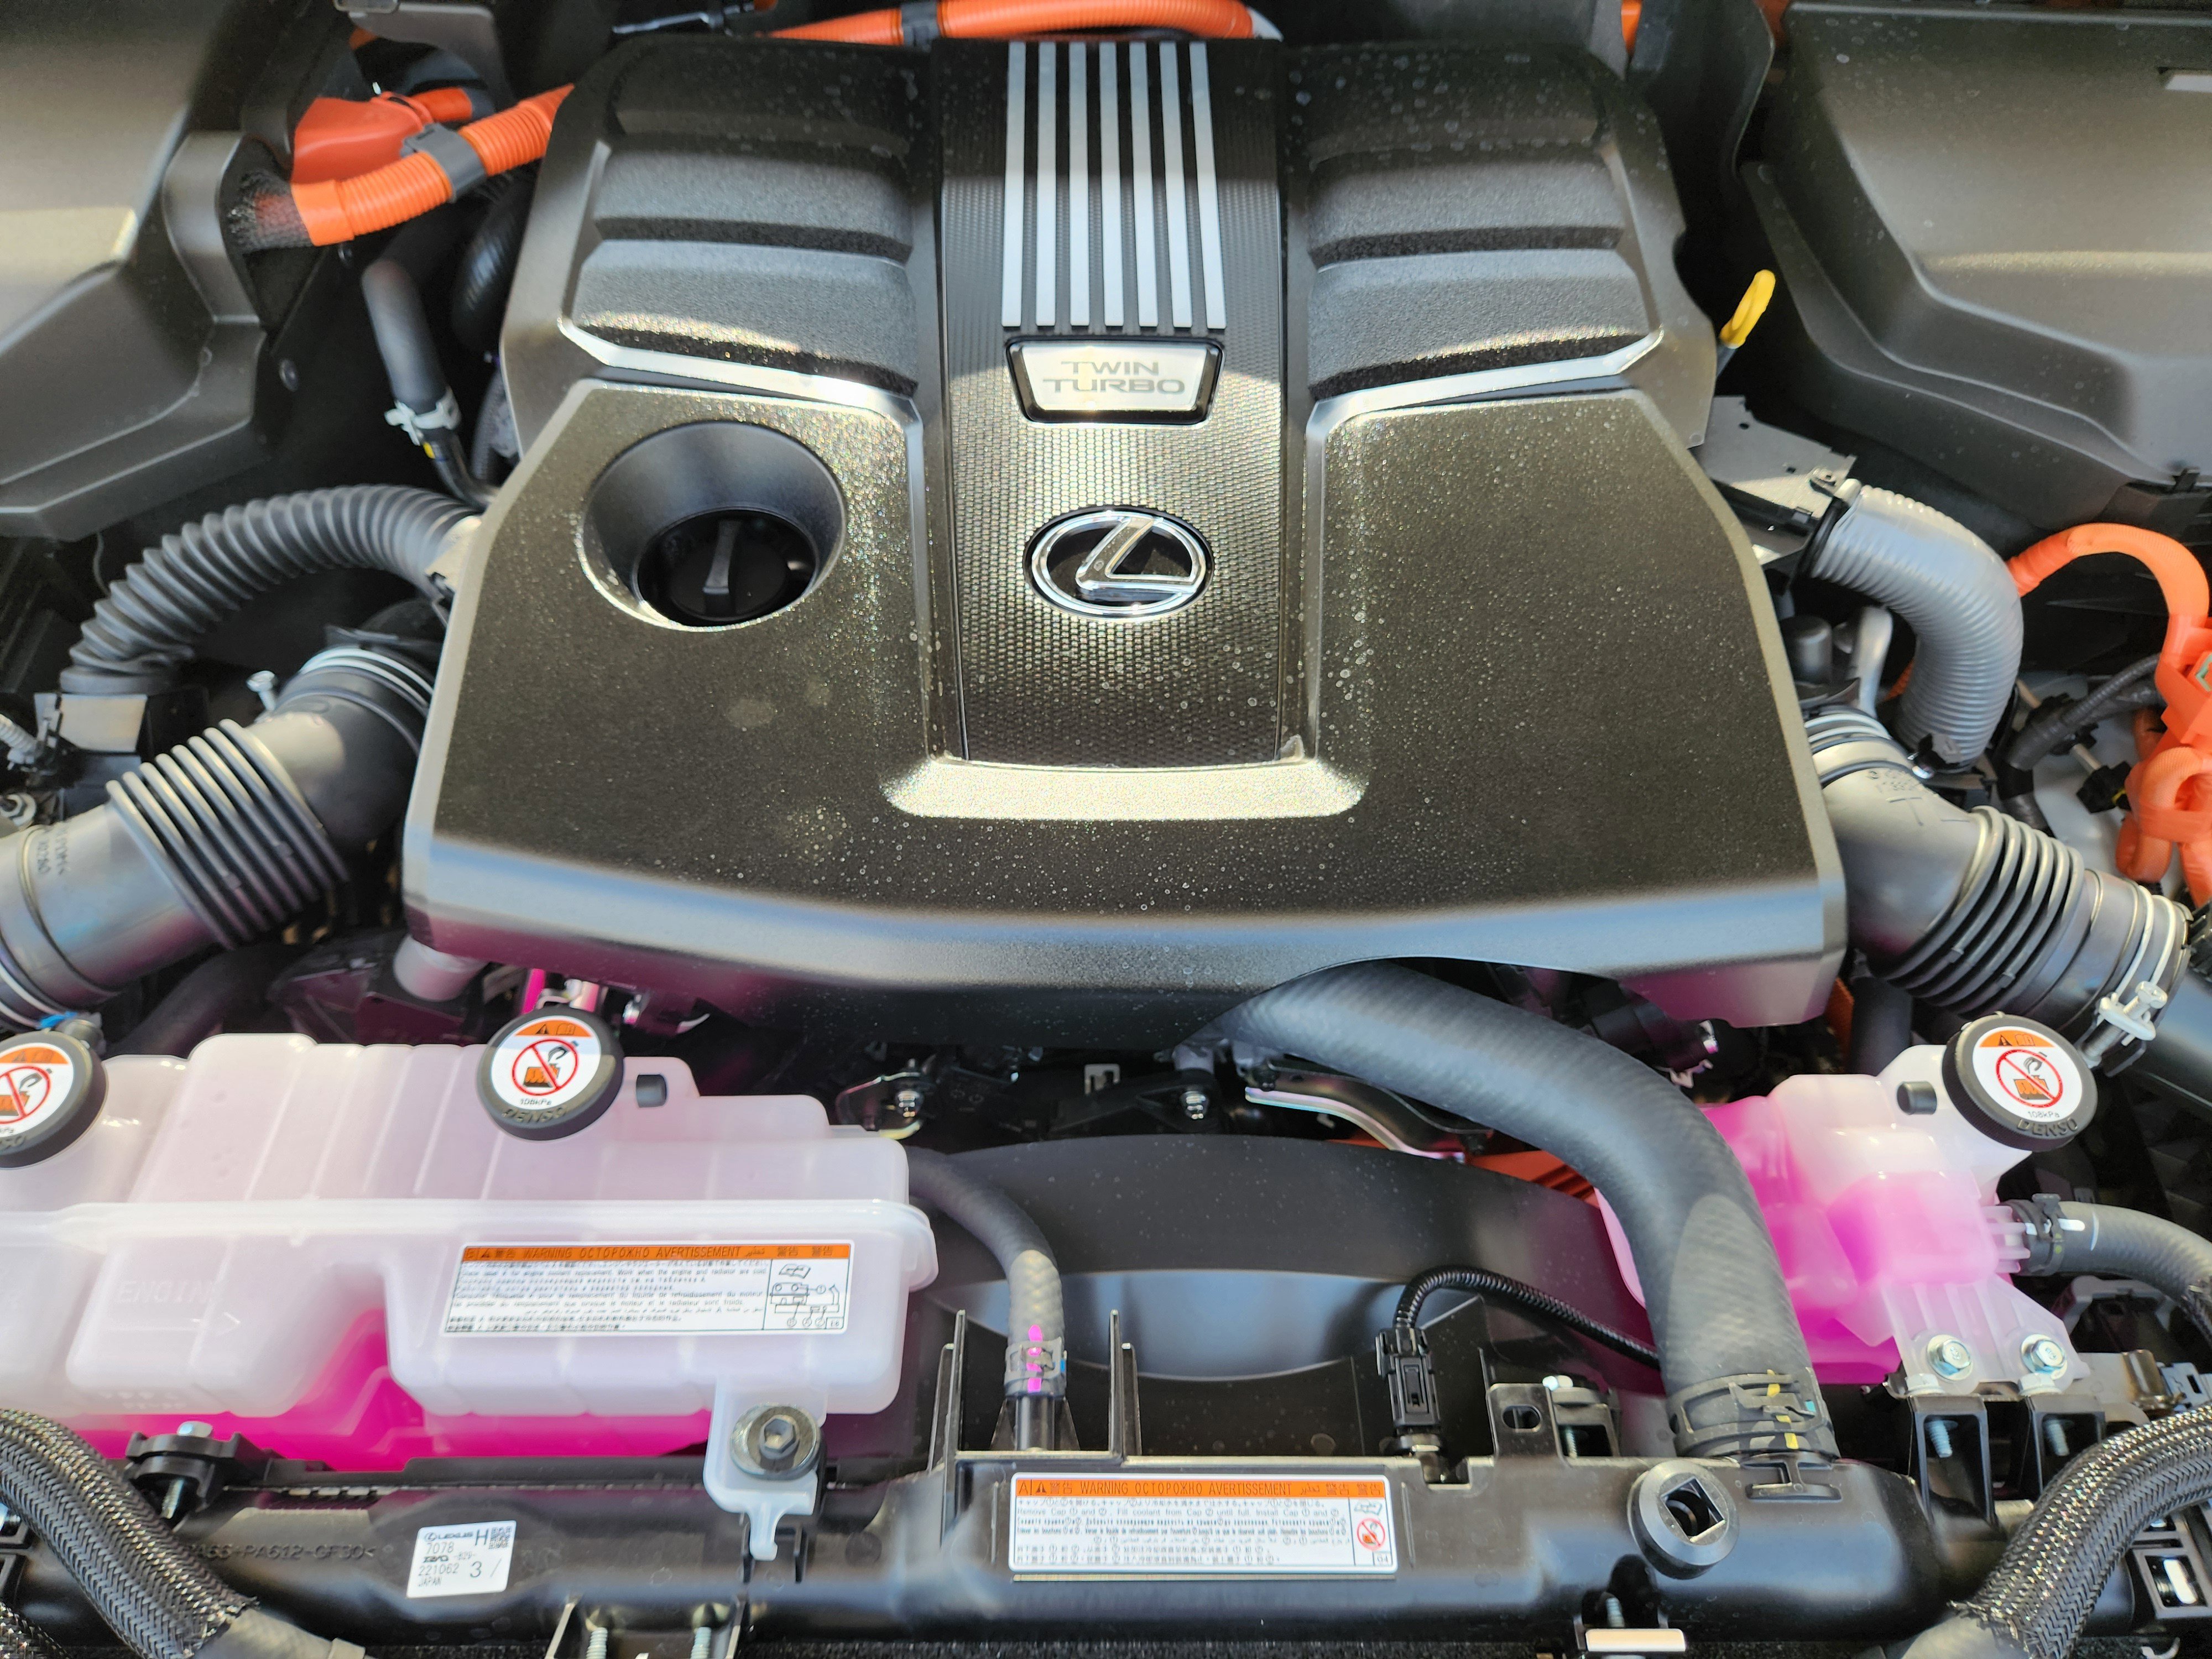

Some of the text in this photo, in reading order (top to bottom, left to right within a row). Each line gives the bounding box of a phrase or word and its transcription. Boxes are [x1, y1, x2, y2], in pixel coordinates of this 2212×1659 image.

[1061, 361, 1159, 376] TWIN
[1043, 379, 1186, 394] TURBO
[502, 1107, 567, 1123] DENSO
[2017, 1118, 2078, 1136] DENSO
[525, 1248, 573, 1259] WARNING
[580, 1247, 650, 1259] ОСТОРОЖНО
[655, 1246, 742, 1258] AVERTISSEMENT
[1019, 1482, 1029, 1494] A
[1050, 1481, 1073, 1495] 警告
[1079, 1481, 1129, 1495] WARNING
[1135, 1482, 1203, 1495] ОСТОРОЖНО
[1208, 1482, 1292, 1496] AVERTISSEMENT
[1325, 1483, 1350, 1496] 警告
[1357, 1483, 1381, 1496] 警告
[474, 1528, 489, 1546] H
[426, 1541, 455, 1554] 7078
[469, 1561, 483, 1578] 3
